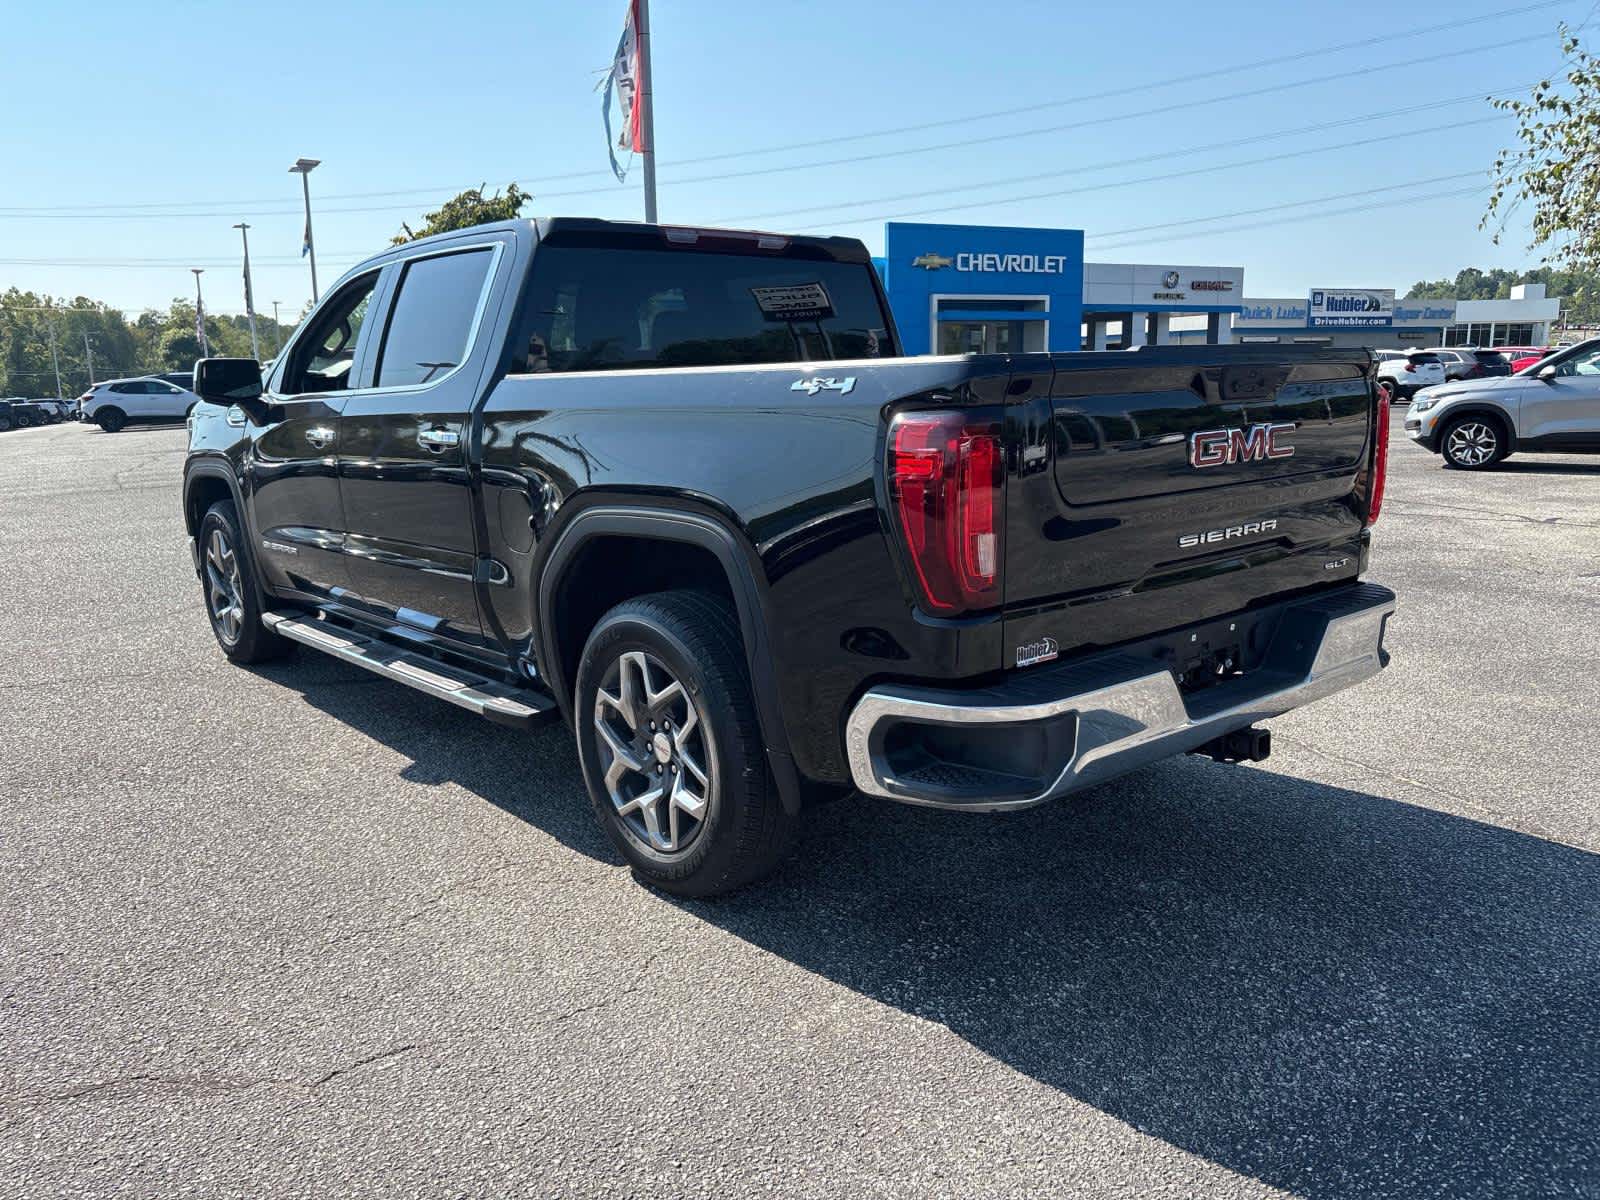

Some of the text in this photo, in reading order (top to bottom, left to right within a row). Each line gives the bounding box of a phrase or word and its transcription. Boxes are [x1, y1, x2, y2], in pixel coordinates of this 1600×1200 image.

[956, 253, 1067, 274] CHEVROLET
[1326, 296, 1368, 312] Hubler
[1315, 317, 1386, 326] DriveHubler.com
[1191, 422, 1296, 468] GMC
[1178, 518, 1278, 548] SIERRA
[1324, 557, 1349, 570] SLT
